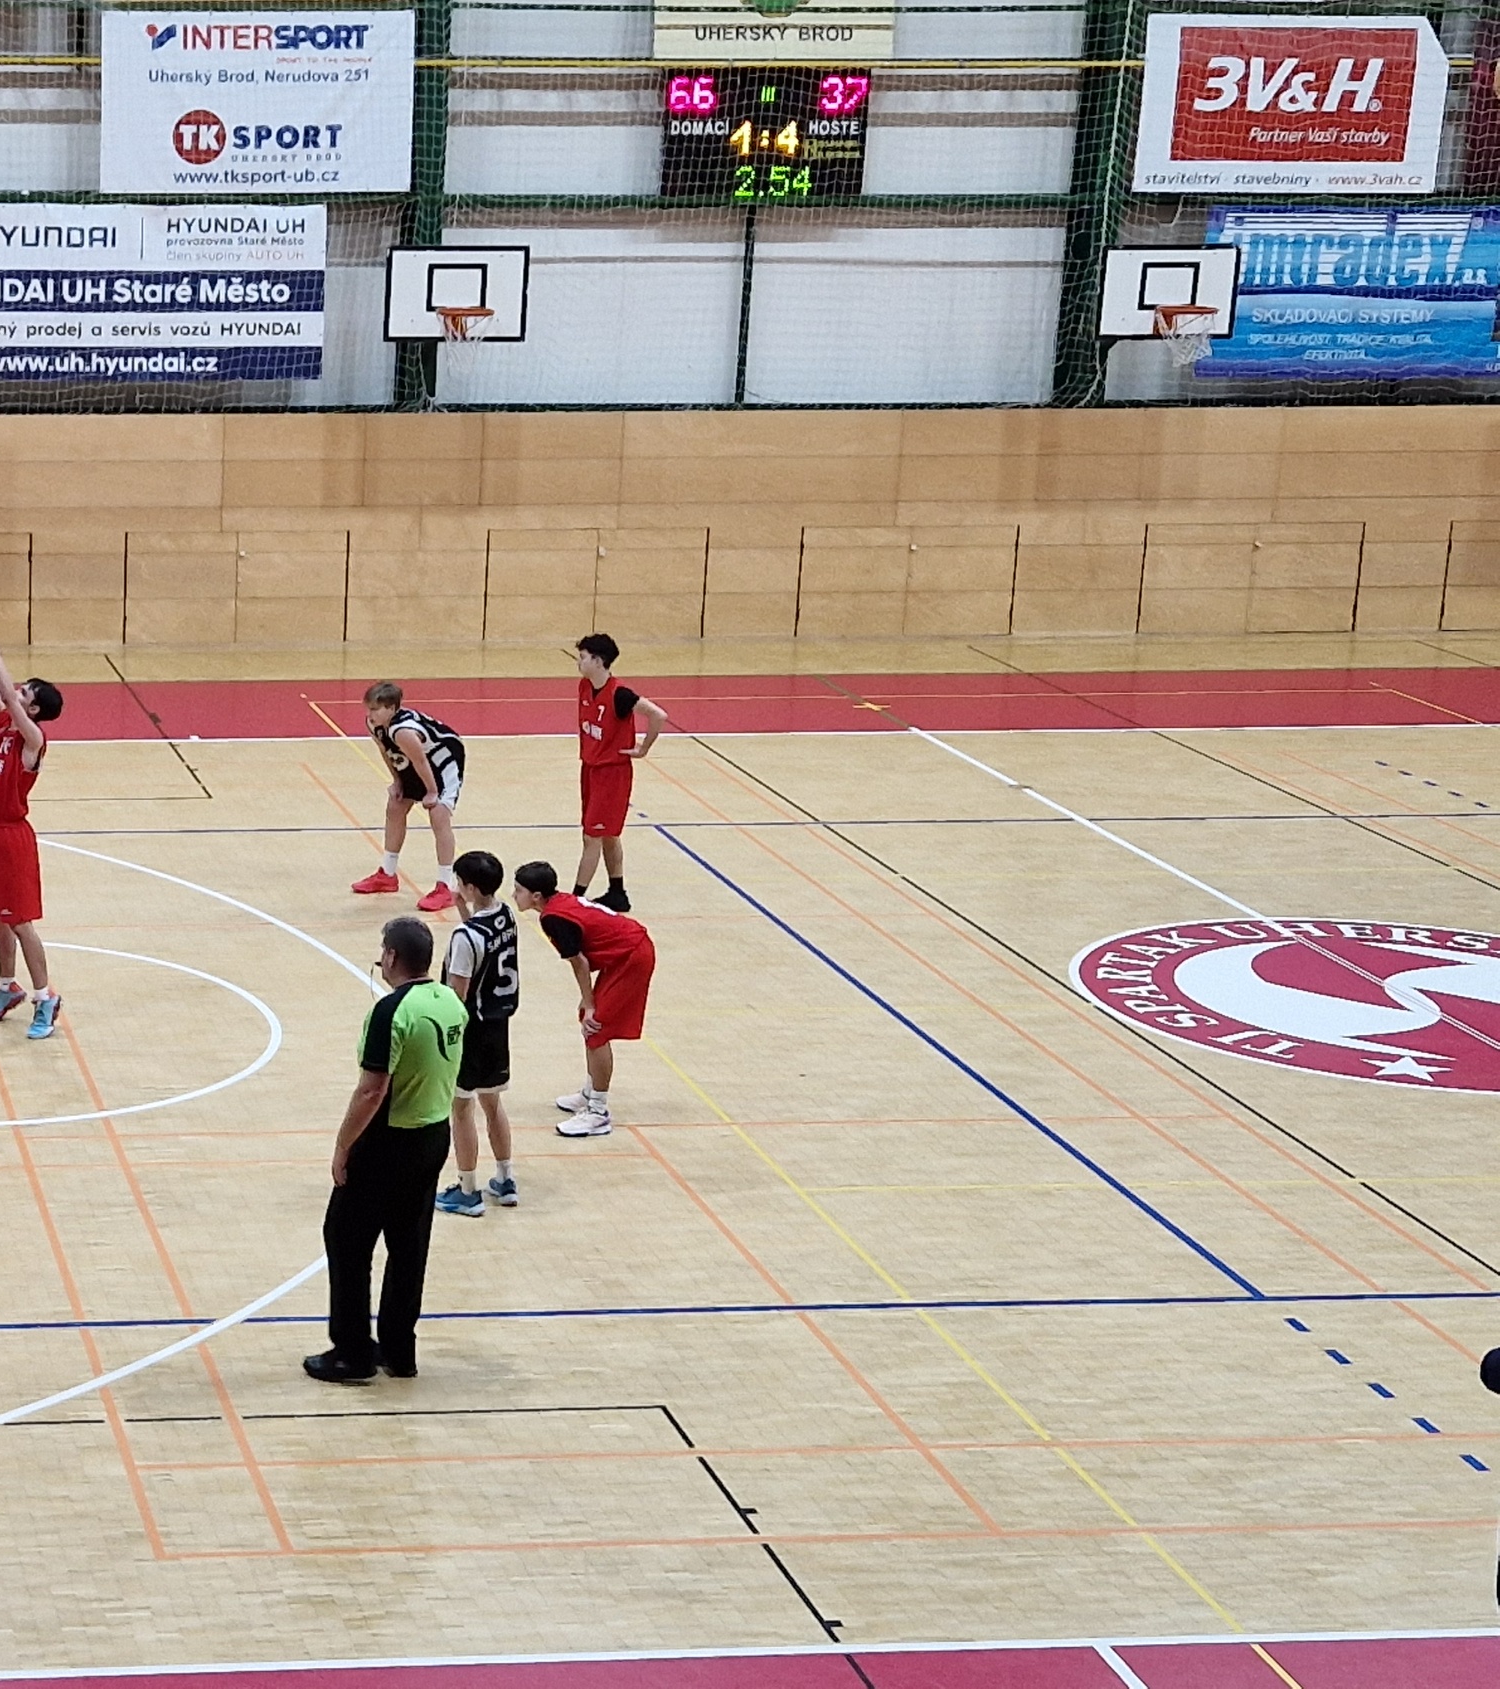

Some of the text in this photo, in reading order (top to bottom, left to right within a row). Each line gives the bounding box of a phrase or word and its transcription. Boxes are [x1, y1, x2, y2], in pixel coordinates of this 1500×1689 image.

[182, 24, 368, 50] INTERSPORT
[799, 26, 853, 41] BROD
[149, 69, 369, 86] Uherský Brod, Nerudova 251
[669, 76, 716, 109] 66
[821, 76, 868, 109] 37
[180, 124, 342, 151] TK SPORT
[1249, 127, 1305, 142] Partner
[1341, 127, 1390, 146] stavby
[173, 168, 339, 186] www.tksport-ub.cz
[167, 218, 305, 233] HYUNDAI UH
[63, 278, 105, 302] UH
[113, 276, 191, 304] Staré
[200, 276, 290, 304] Město
[27, 322, 82, 338] prodej
[91, 324, 102, 336] a
[112, 322, 161, 337] servis
[170, 320, 210, 337] vozů
[220, 322, 301, 337] HYUNDAI
[598, 705, 605, 721] 7
[493, 946, 517, 996] 5
[1096, 921, 1500, 1059] TJ SPARTAK UHERS
